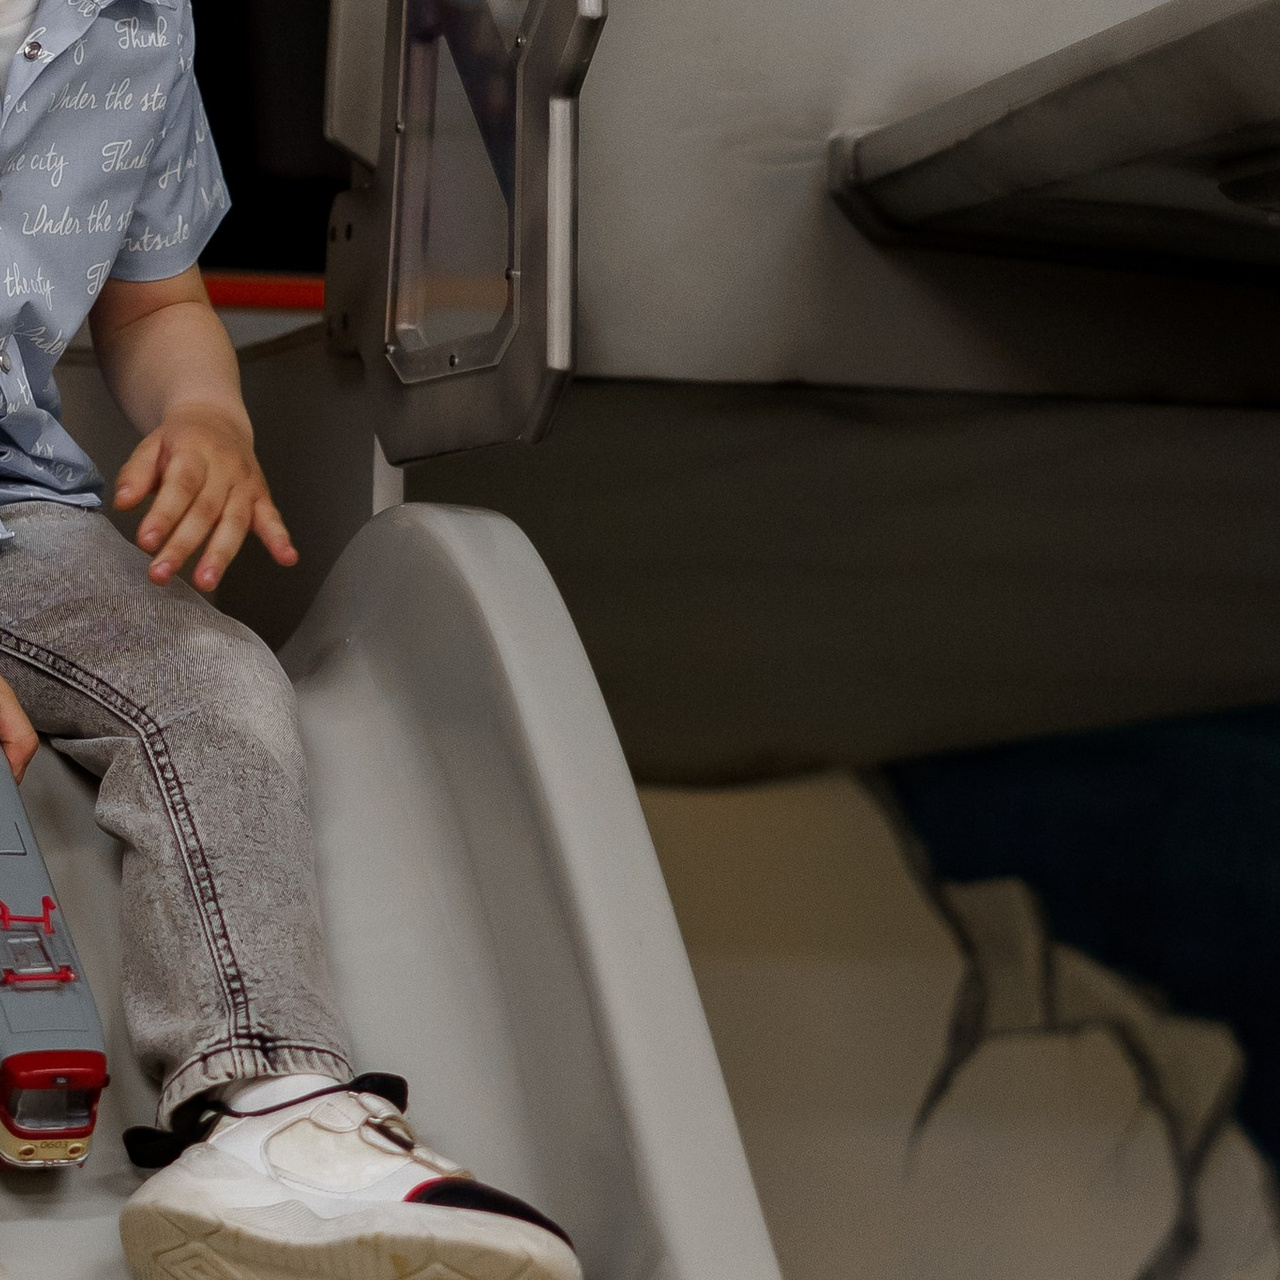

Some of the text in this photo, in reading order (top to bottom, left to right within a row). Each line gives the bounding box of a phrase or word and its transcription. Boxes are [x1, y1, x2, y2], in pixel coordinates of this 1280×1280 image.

[114, 16, 170, 50] Think
[104, 77, 134, 111] the
[29, 142, 69, 188] city
[21, 203, 82, 237] Under
[87, 199, 112, 235] the
